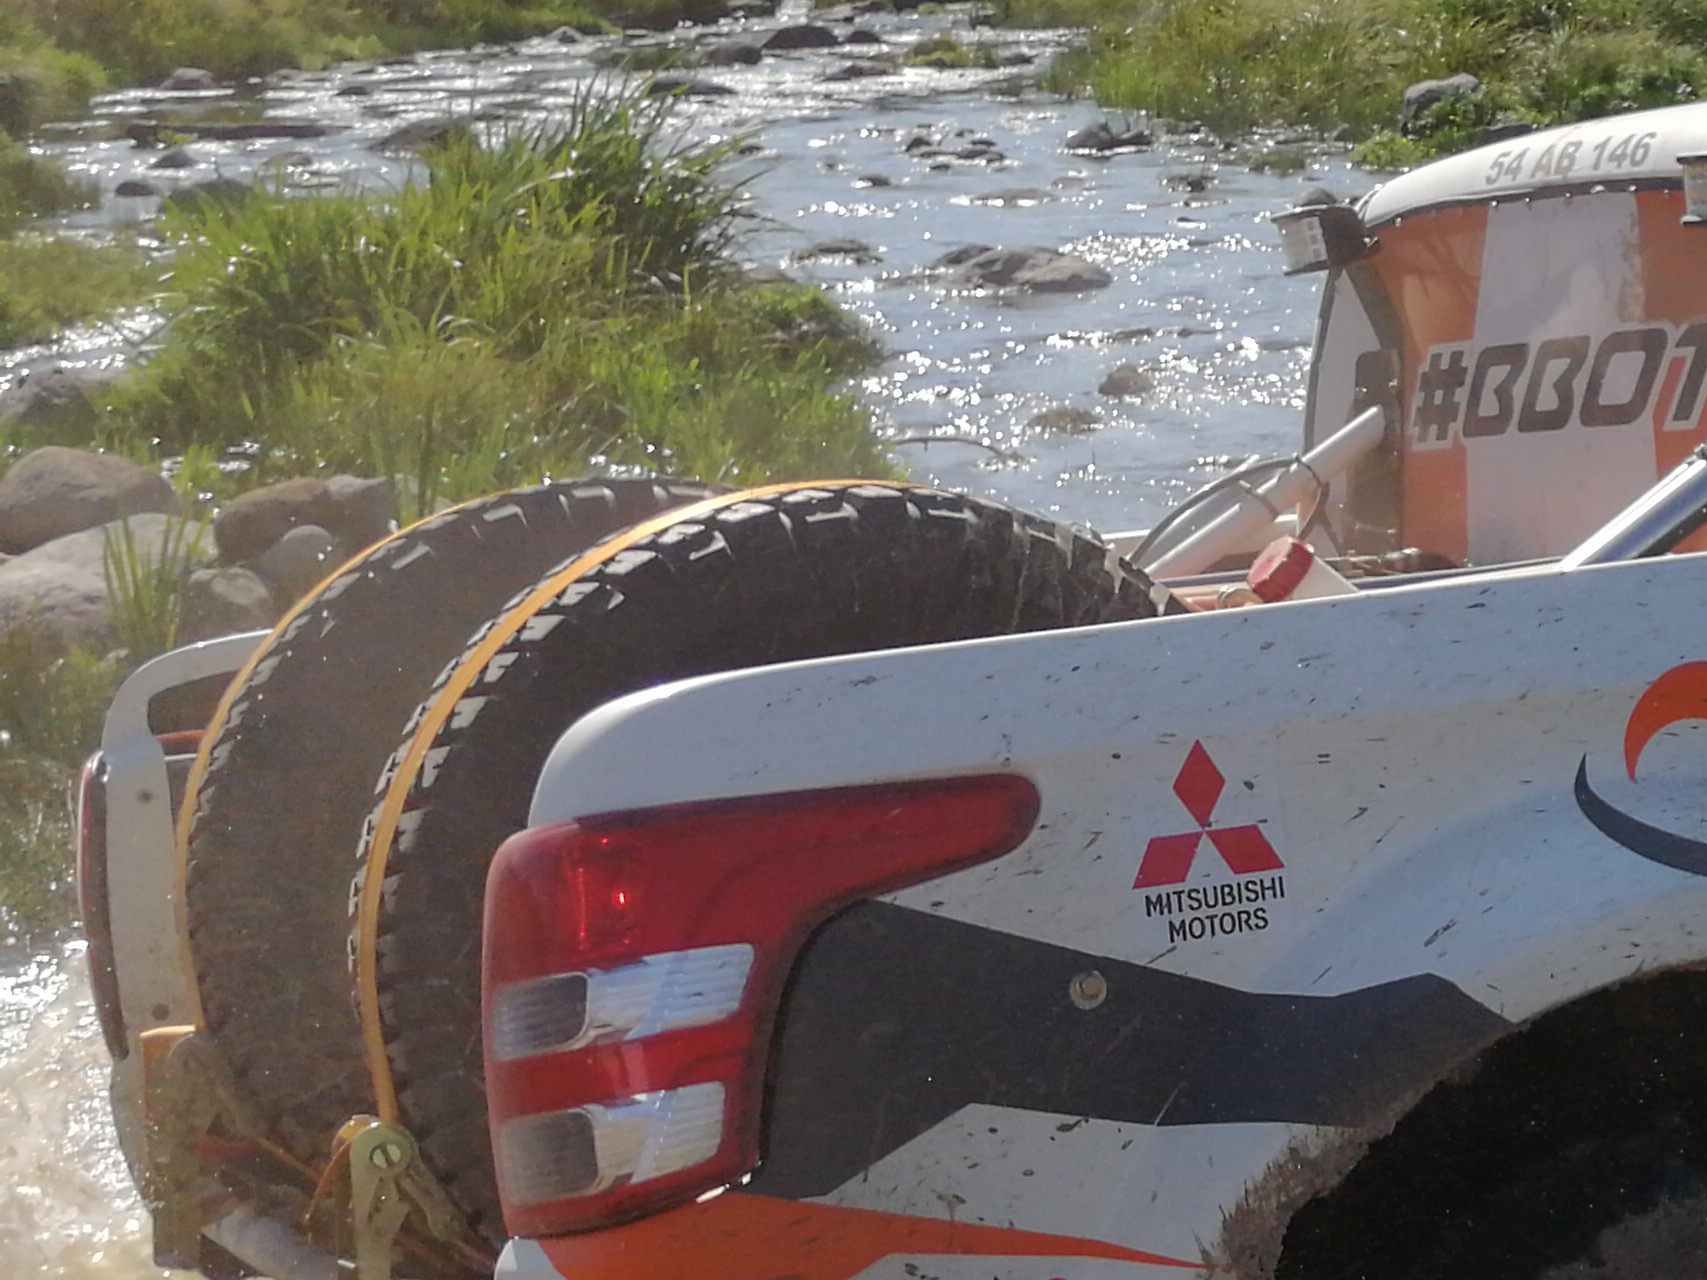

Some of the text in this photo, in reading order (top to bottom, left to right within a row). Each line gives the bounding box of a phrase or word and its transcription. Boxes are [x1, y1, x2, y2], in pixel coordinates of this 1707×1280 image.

[1485, 131, 1657, 185] 54 AB 146
[1144, 875, 1286, 918] MITSUBISHI
[1168, 907, 1269, 943] MOTORS
